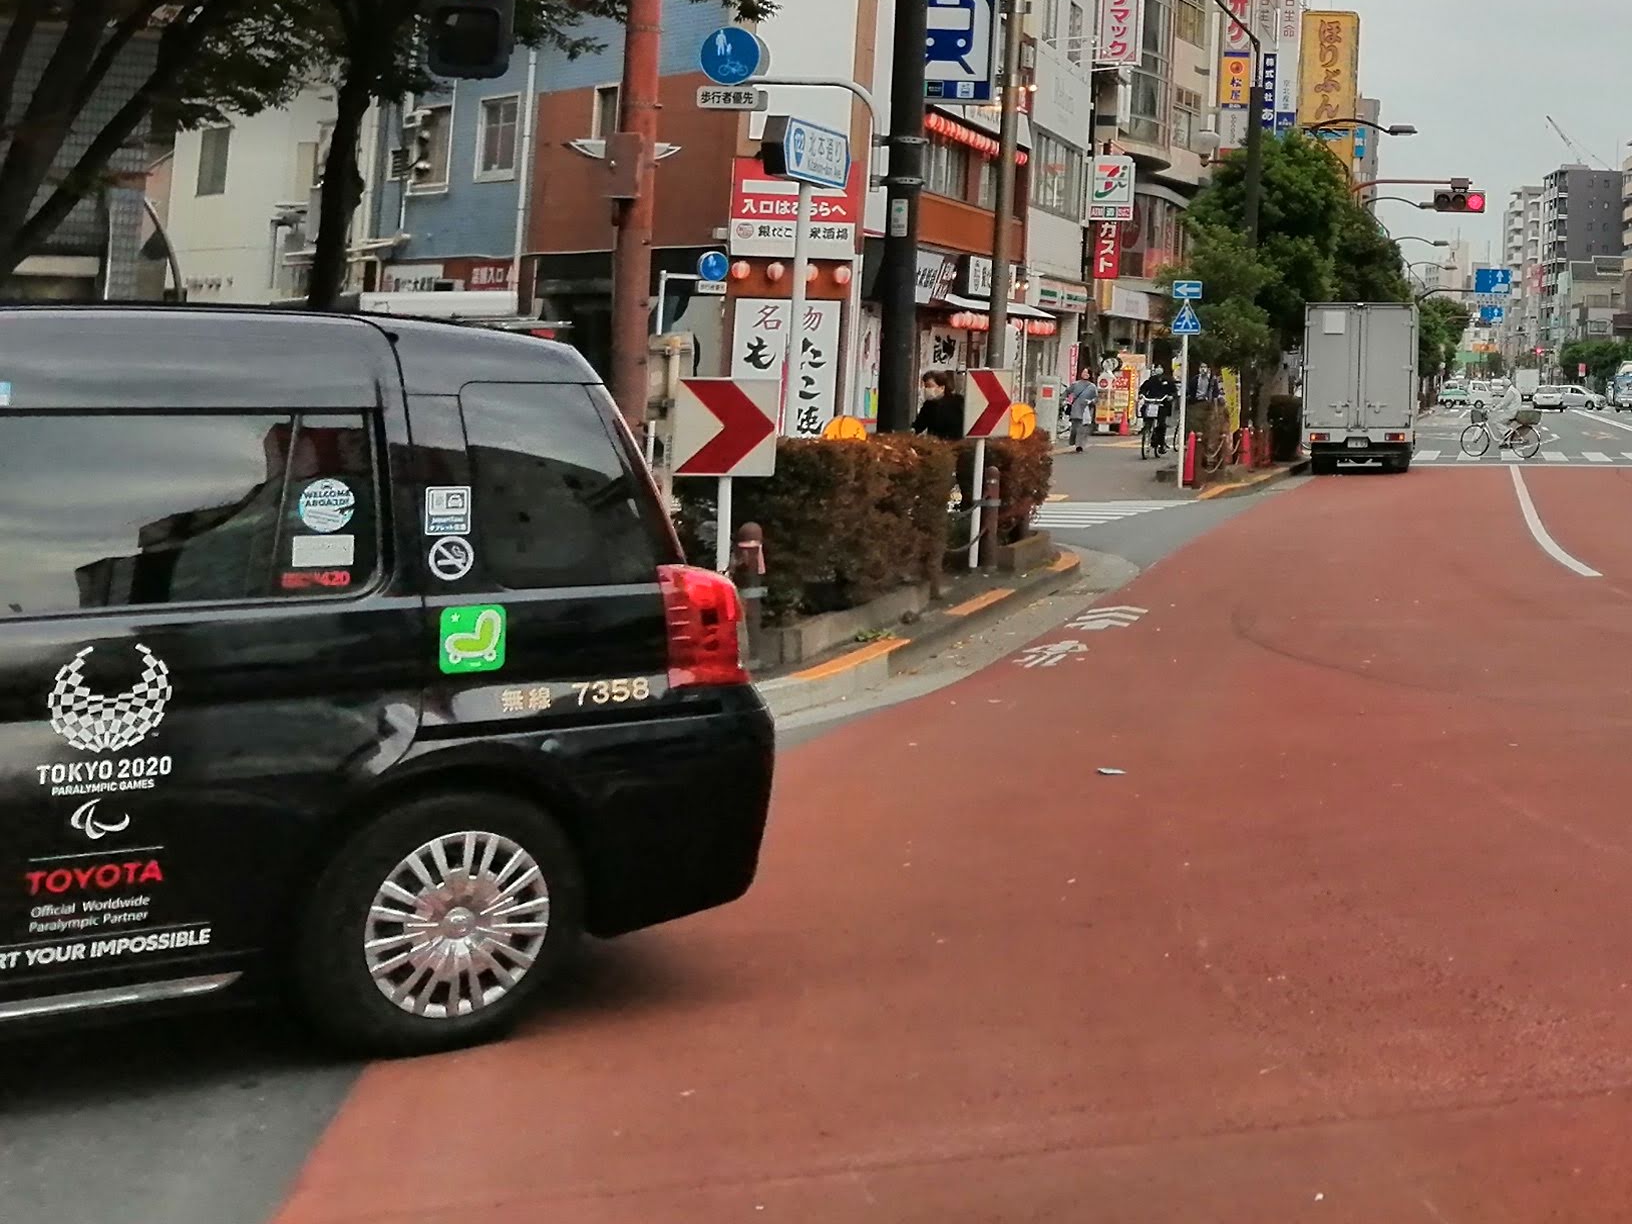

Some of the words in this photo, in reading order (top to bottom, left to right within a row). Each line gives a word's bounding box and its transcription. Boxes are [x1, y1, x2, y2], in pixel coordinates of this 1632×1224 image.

[1264, 57, 1275, 102] 株式会社
[1314, 19, 1342, 119] ほりぶん
[700, 91, 754, 105] 歩行者優先
[757, 224, 849, 241] 銀だこ衆酒場
[304, 490, 350, 499] WELCOME
[501, 687, 552, 713] 無線
[571, 676, 650, 707] 7358
[36, 759, 114, 785] TOKYO
[117, 755, 173, 779] 2020
[51, 782, 118, 796] PARALYMPIC
[119, 778, 155, 791] GAMES
[26, 859, 164, 895] TOYOTA
[31, 903, 76, 919] Official
[82, 894, 151, 912] Worldwide
[28, 914, 99, 933] Paralympic
[102, 909, 149, 925] Partner
[25, 943, 87, 967] YOUR
[90, 927, 212, 958] IMPOSSIBLE
